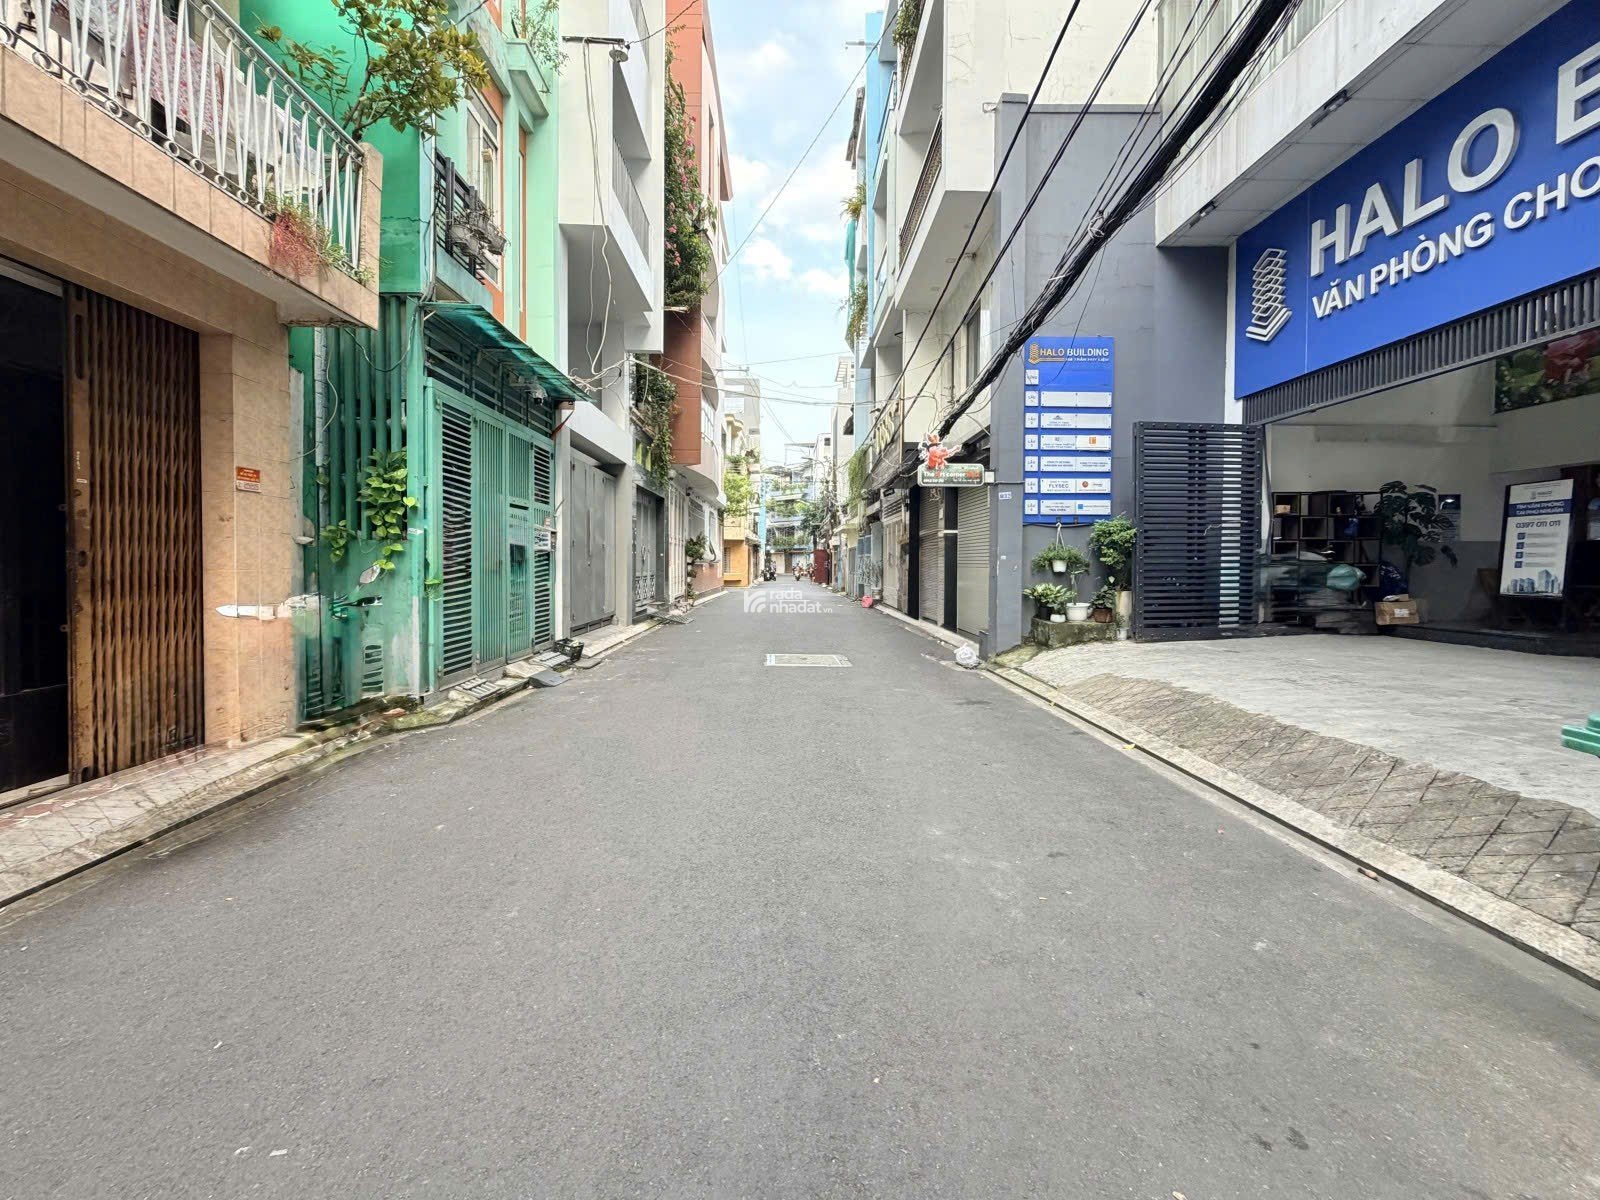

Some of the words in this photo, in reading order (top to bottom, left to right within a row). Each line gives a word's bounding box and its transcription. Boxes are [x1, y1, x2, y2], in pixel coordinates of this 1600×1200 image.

[1311, 108, 1519, 277] HALO
[1312, 274, 1365, 319] VĂN
[1370, 212, 1495, 295] PHÒNG
[1504, 155, 1600, 230] CHO
[1040, 348, 1065, 356] HALO
[1066, 348, 1109, 357] BUILDING
